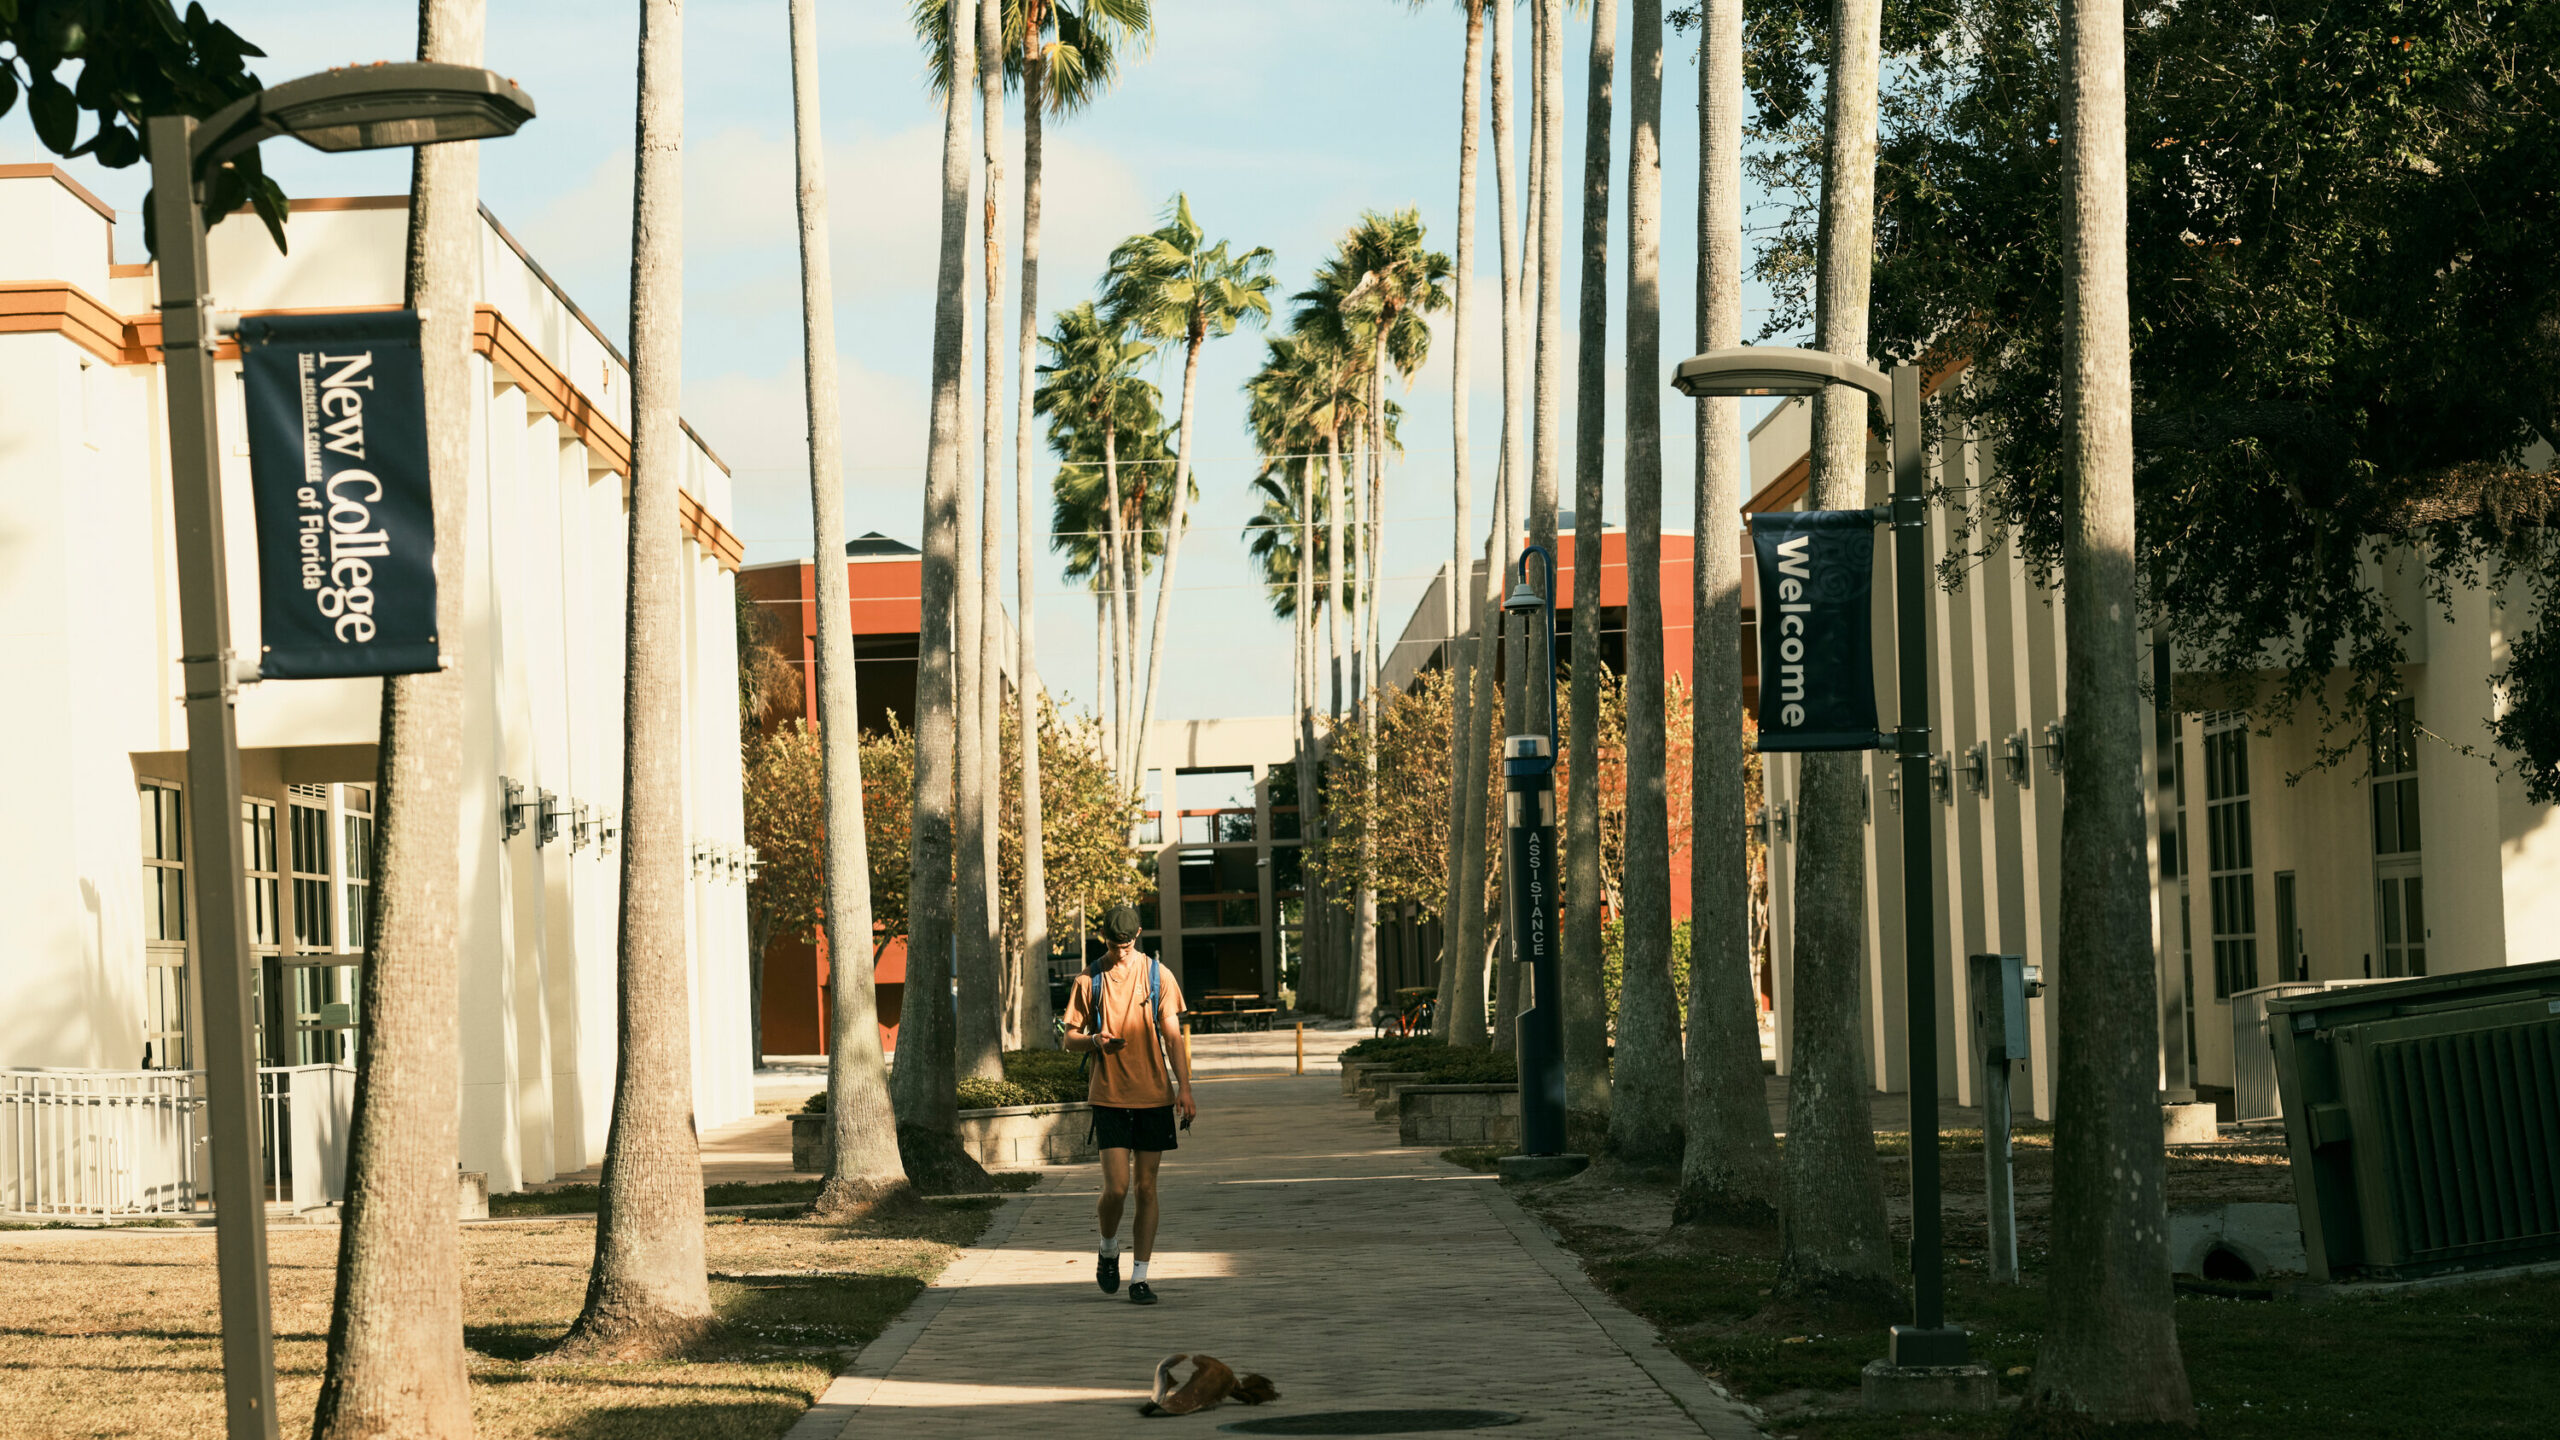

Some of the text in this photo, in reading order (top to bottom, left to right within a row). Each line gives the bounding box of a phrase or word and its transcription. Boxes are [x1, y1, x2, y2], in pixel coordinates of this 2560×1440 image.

[297, 486, 327, 590] of Florida
[316, 350, 390, 643] New College
[1777, 535, 1812, 727] Welcome
[1529, 832, 1544, 955] ASSISTANCE
